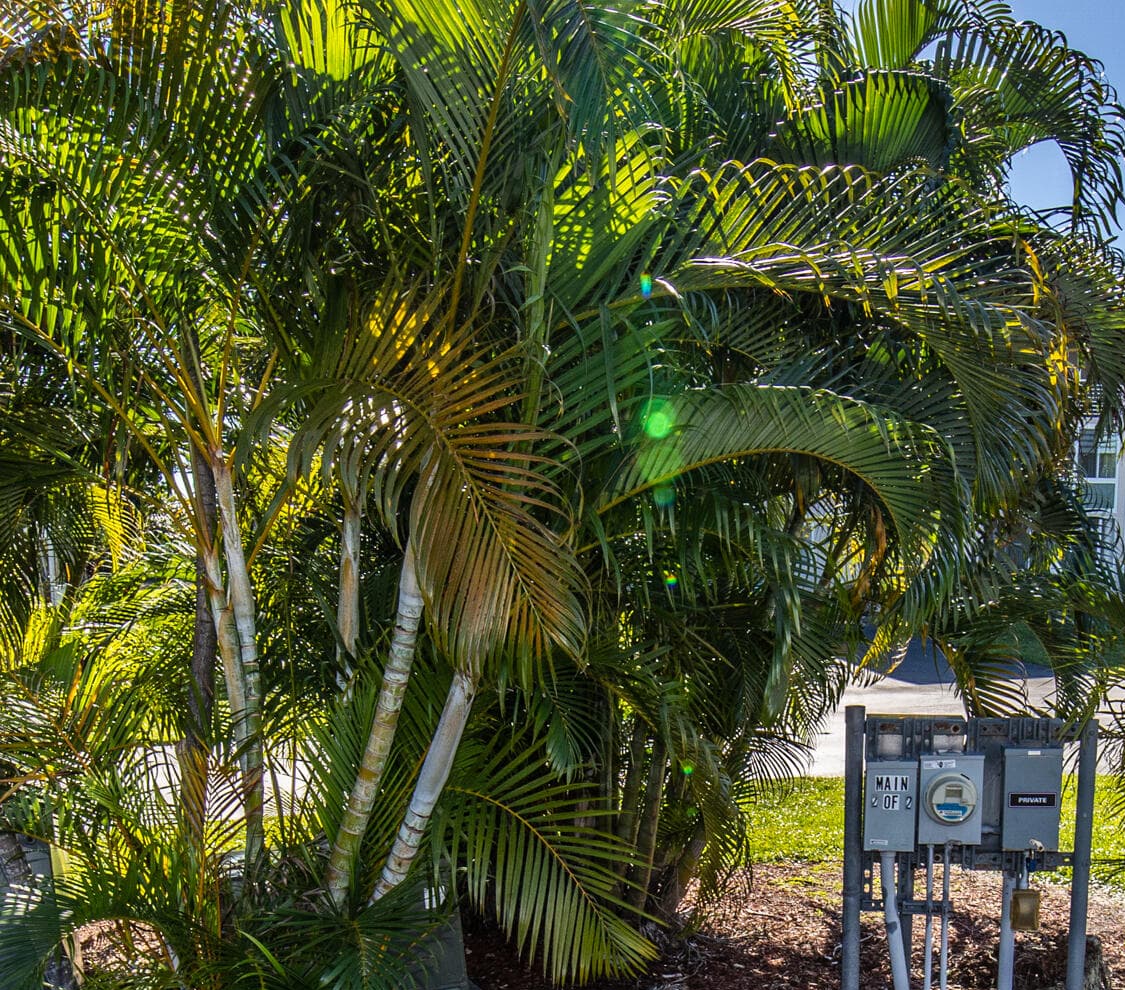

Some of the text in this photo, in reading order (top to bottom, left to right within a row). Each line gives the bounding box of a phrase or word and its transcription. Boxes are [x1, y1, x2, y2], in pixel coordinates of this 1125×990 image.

[876, 776, 908, 791] MAIN
[883, 795, 898, 809] OF
[905, 796, 913, 809] 2
[1018, 796, 1047, 804] PRIVATE
